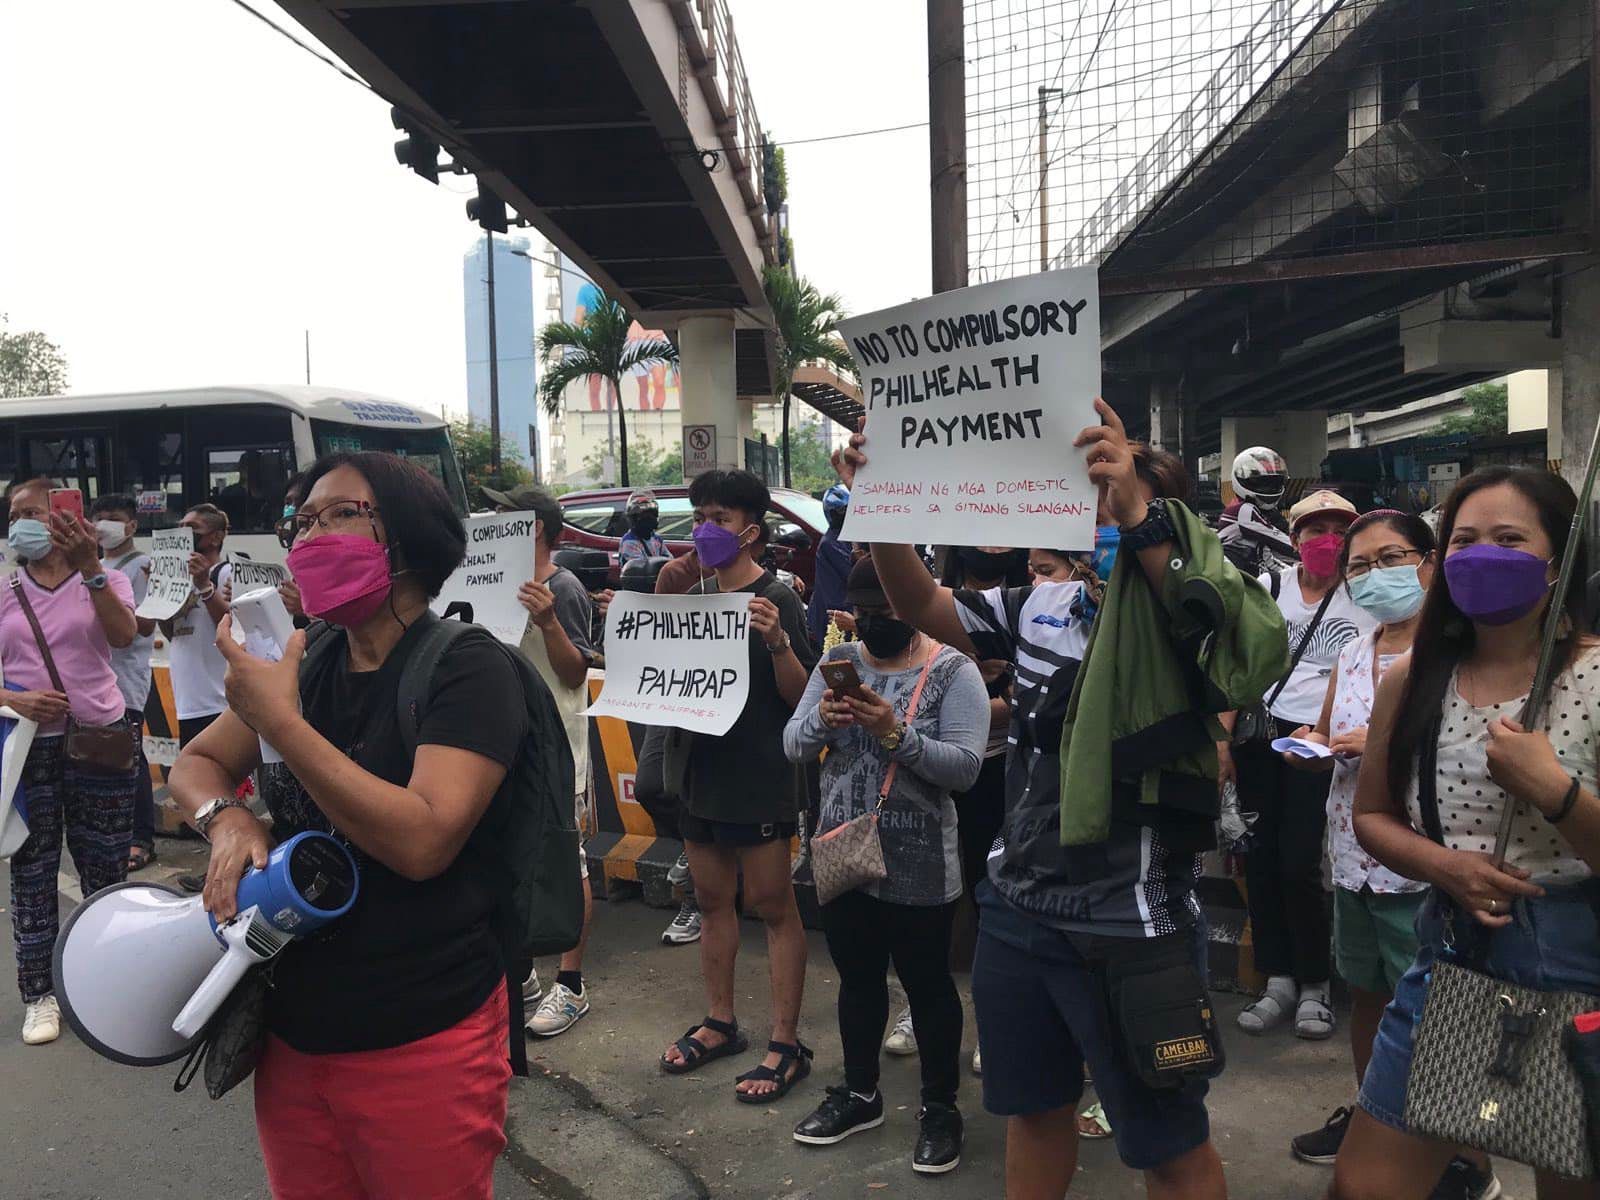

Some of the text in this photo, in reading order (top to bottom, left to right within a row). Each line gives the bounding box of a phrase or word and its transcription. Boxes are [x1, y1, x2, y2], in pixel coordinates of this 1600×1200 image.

[854, 299, 1087, 366] NO TO COMPULSORY
[869, 354, 1039, 410] PHILHEALTH
[901, 408, 1043, 449] PAYMENT
[930, 482, 949, 496] NG
[957, 481, 986, 496] MGA
[996, 478, 1069, 495] DOMESTIC
[853, 503, 912, 515] HELPERS
[926, 503, 941, 513] SA
[955, 502, 1009, 515] GITNANG
[473, 520, 534, 543] COMPULSORY
[465, 571, 504, 586] PAYMENT
[616, 611, 746, 640] #PHILHEALTH
[637, 666, 738, 699] PAHIRAP
[1155, 1039, 1207, 1060] CAMELBAK
